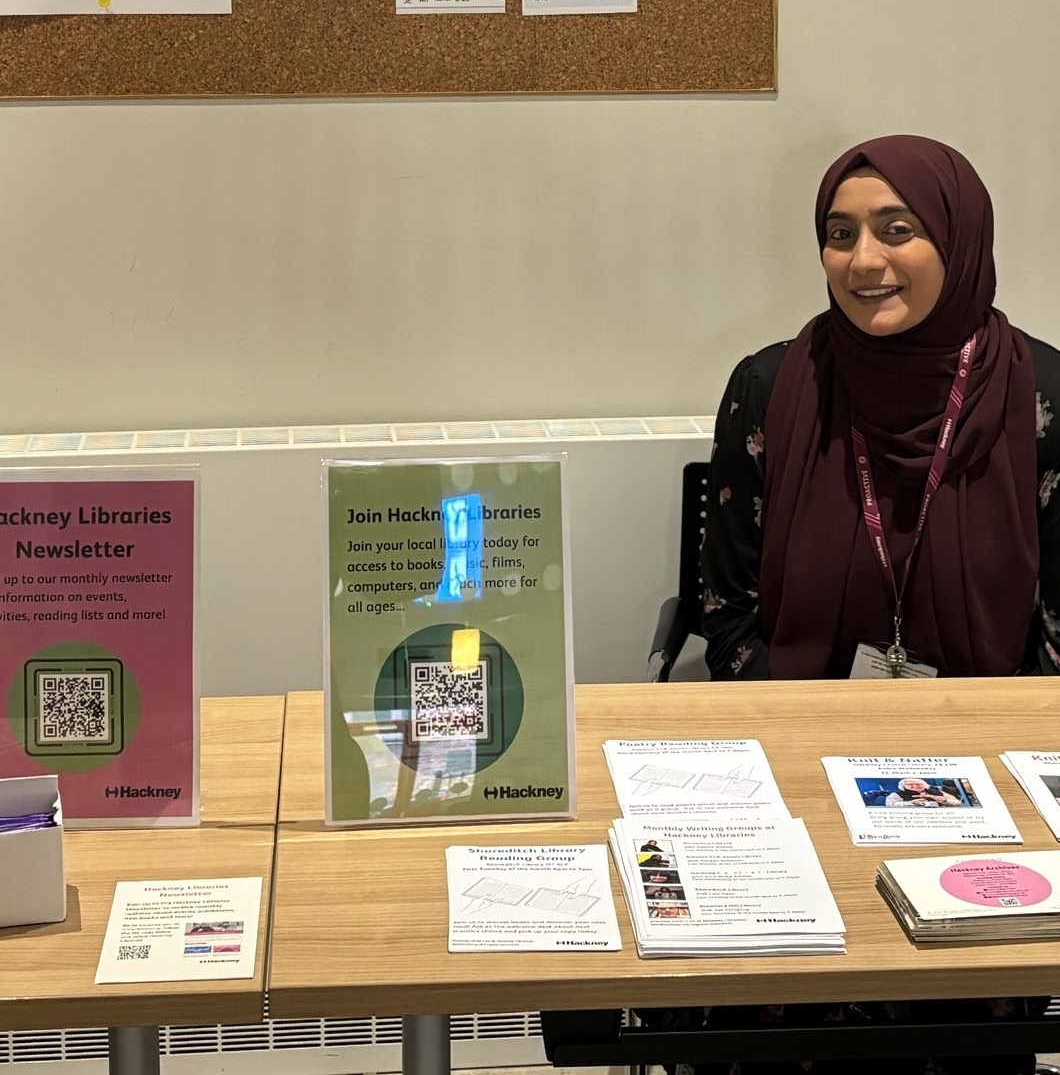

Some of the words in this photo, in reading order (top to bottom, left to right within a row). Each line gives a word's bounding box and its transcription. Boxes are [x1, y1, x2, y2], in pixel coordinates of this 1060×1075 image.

[861, 470, 873, 506] PROACTIVE
[0, 508, 71, 529] ackney
[79, 507, 171, 524] Libraries
[347, 509, 381, 523] Join
[17, 541, 134, 558] Newsletter
[348, 541, 372, 552] Join
[376, 543, 404, 553] your
[408, 539, 435, 549] local
[484, 537, 518, 550] today
[523, 536, 539, 546] for
[348, 563, 387, 572] access
[391, 561, 403, 570] to
[408, 557, 445, 572] books,
[493, 557, 524, 567] films,
[4, 577, 18, 586] up
[22, 575, 34, 584] to
[61, 573, 108, 586] monthly
[112, 574, 172, 582] newsletter
[348, 582, 416, 592] computers,
[420, 579, 442, 590] and
[485, 580, 516, 588] more
[521, 576, 537, 587] for
[0, 593, 64, 602] nformation
[86, 593, 126, 602] events,
[348, 601, 362, 612] all
[367, 603, 404, 614] ages...
[34, 611, 77, 623] reading
[82, 610, 103, 620] lists
[107, 609, 129, 619] and
[133, 610, 165, 619] more!
[120, 786, 181, 799] Hackney
[500, 786, 563, 799] Hackney
